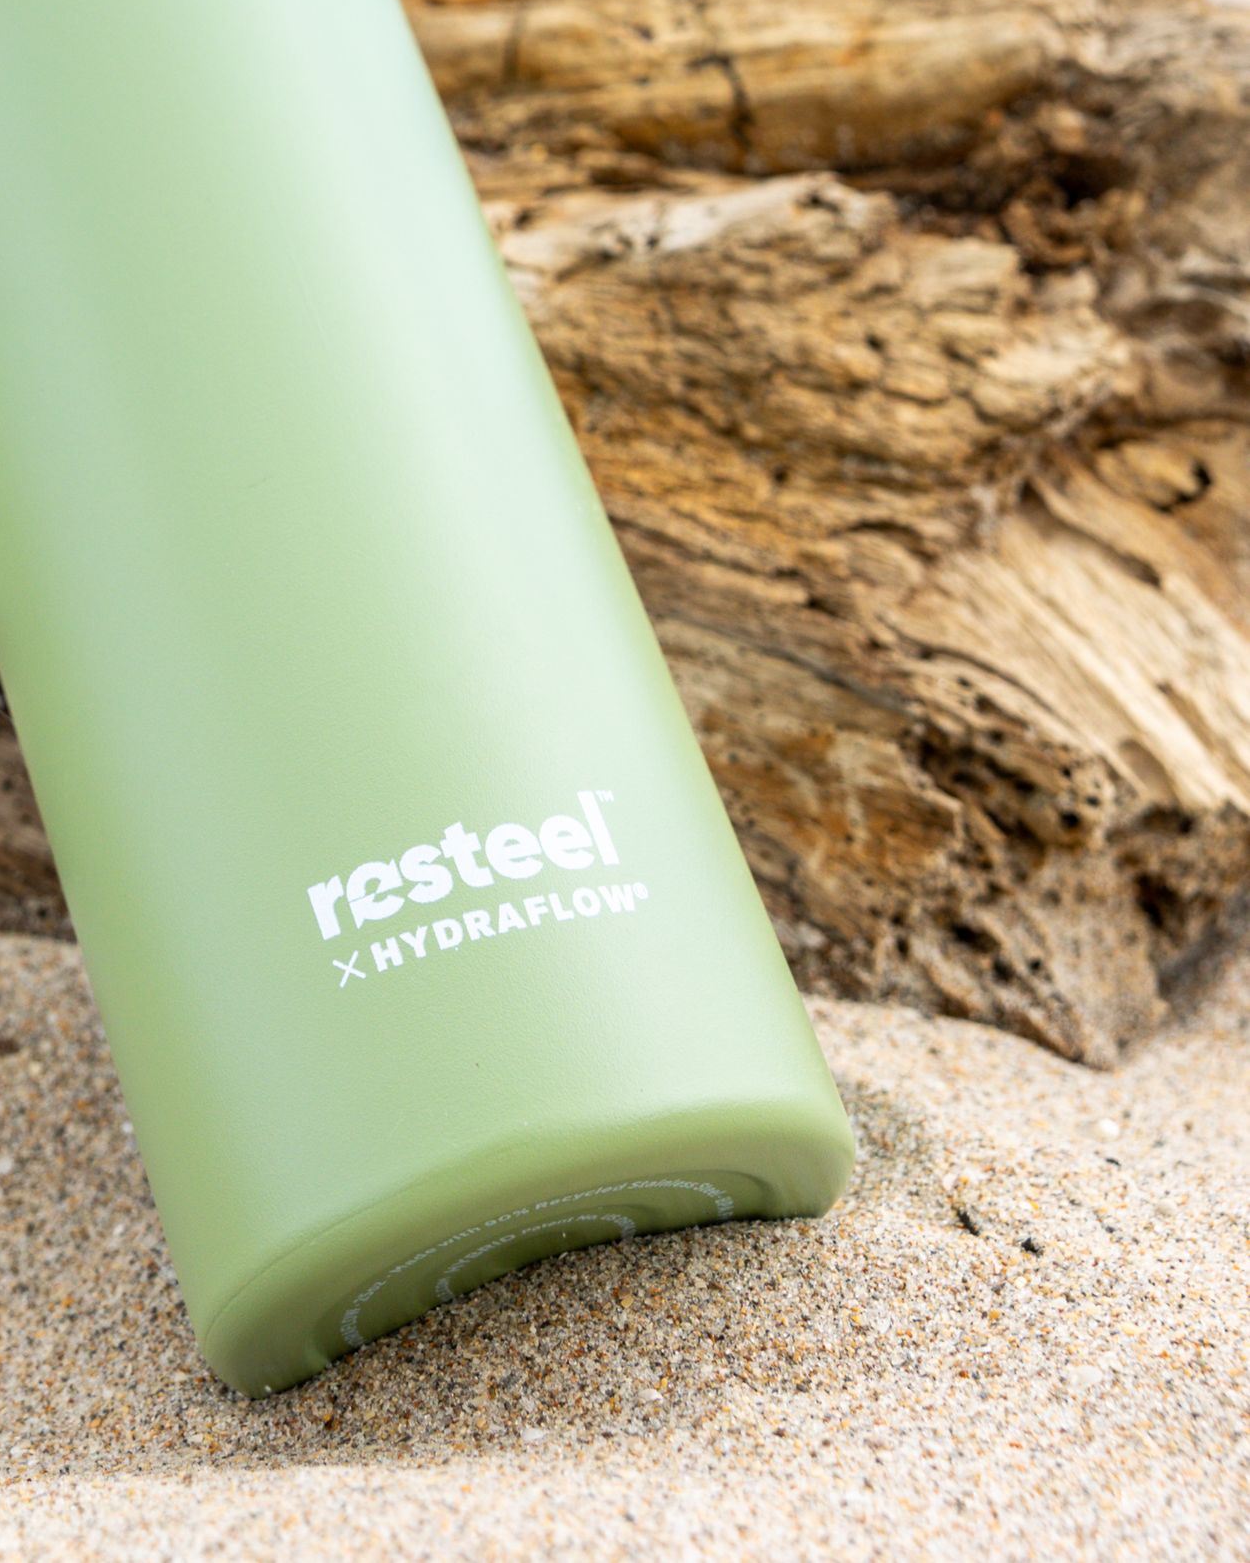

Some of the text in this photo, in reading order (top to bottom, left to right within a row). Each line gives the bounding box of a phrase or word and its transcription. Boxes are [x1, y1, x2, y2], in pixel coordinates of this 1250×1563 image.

[438, 1227, 481, 1248] with
[484, 1207, 529, 1227] 90%
[535, 1182, 628, 1211] Recycled
